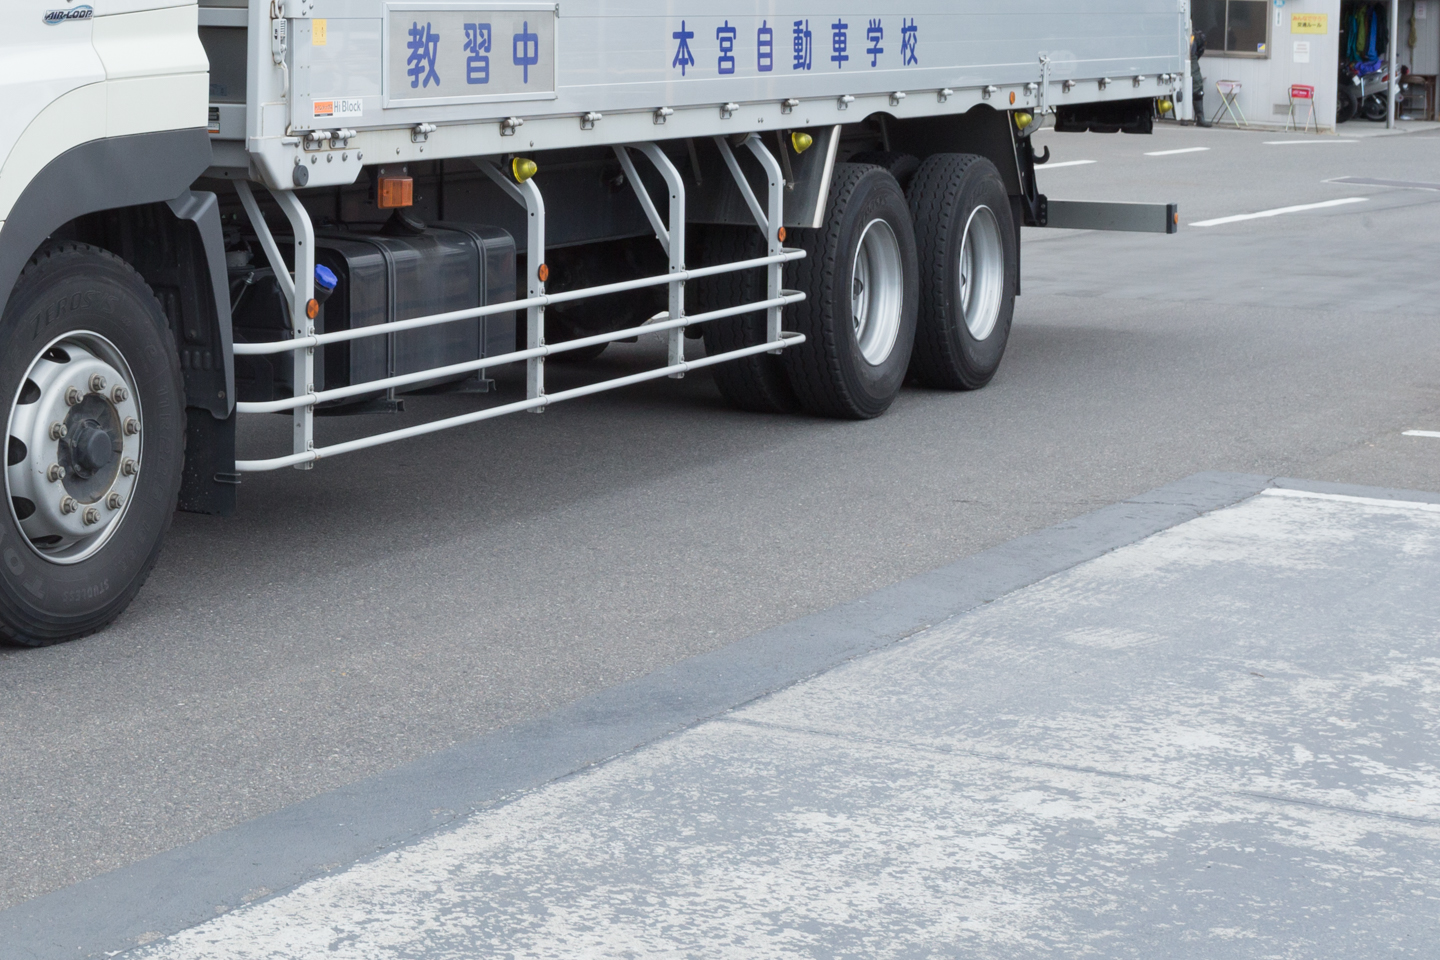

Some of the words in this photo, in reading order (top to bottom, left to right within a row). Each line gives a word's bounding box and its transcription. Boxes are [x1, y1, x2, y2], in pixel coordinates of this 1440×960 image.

[406, 21, 539, 89] 教習中
[672, 17, 919, 77] 本宮自動車学校
[334, 100, 341, 113] Hi
[342, 100, 361, 113] Block
